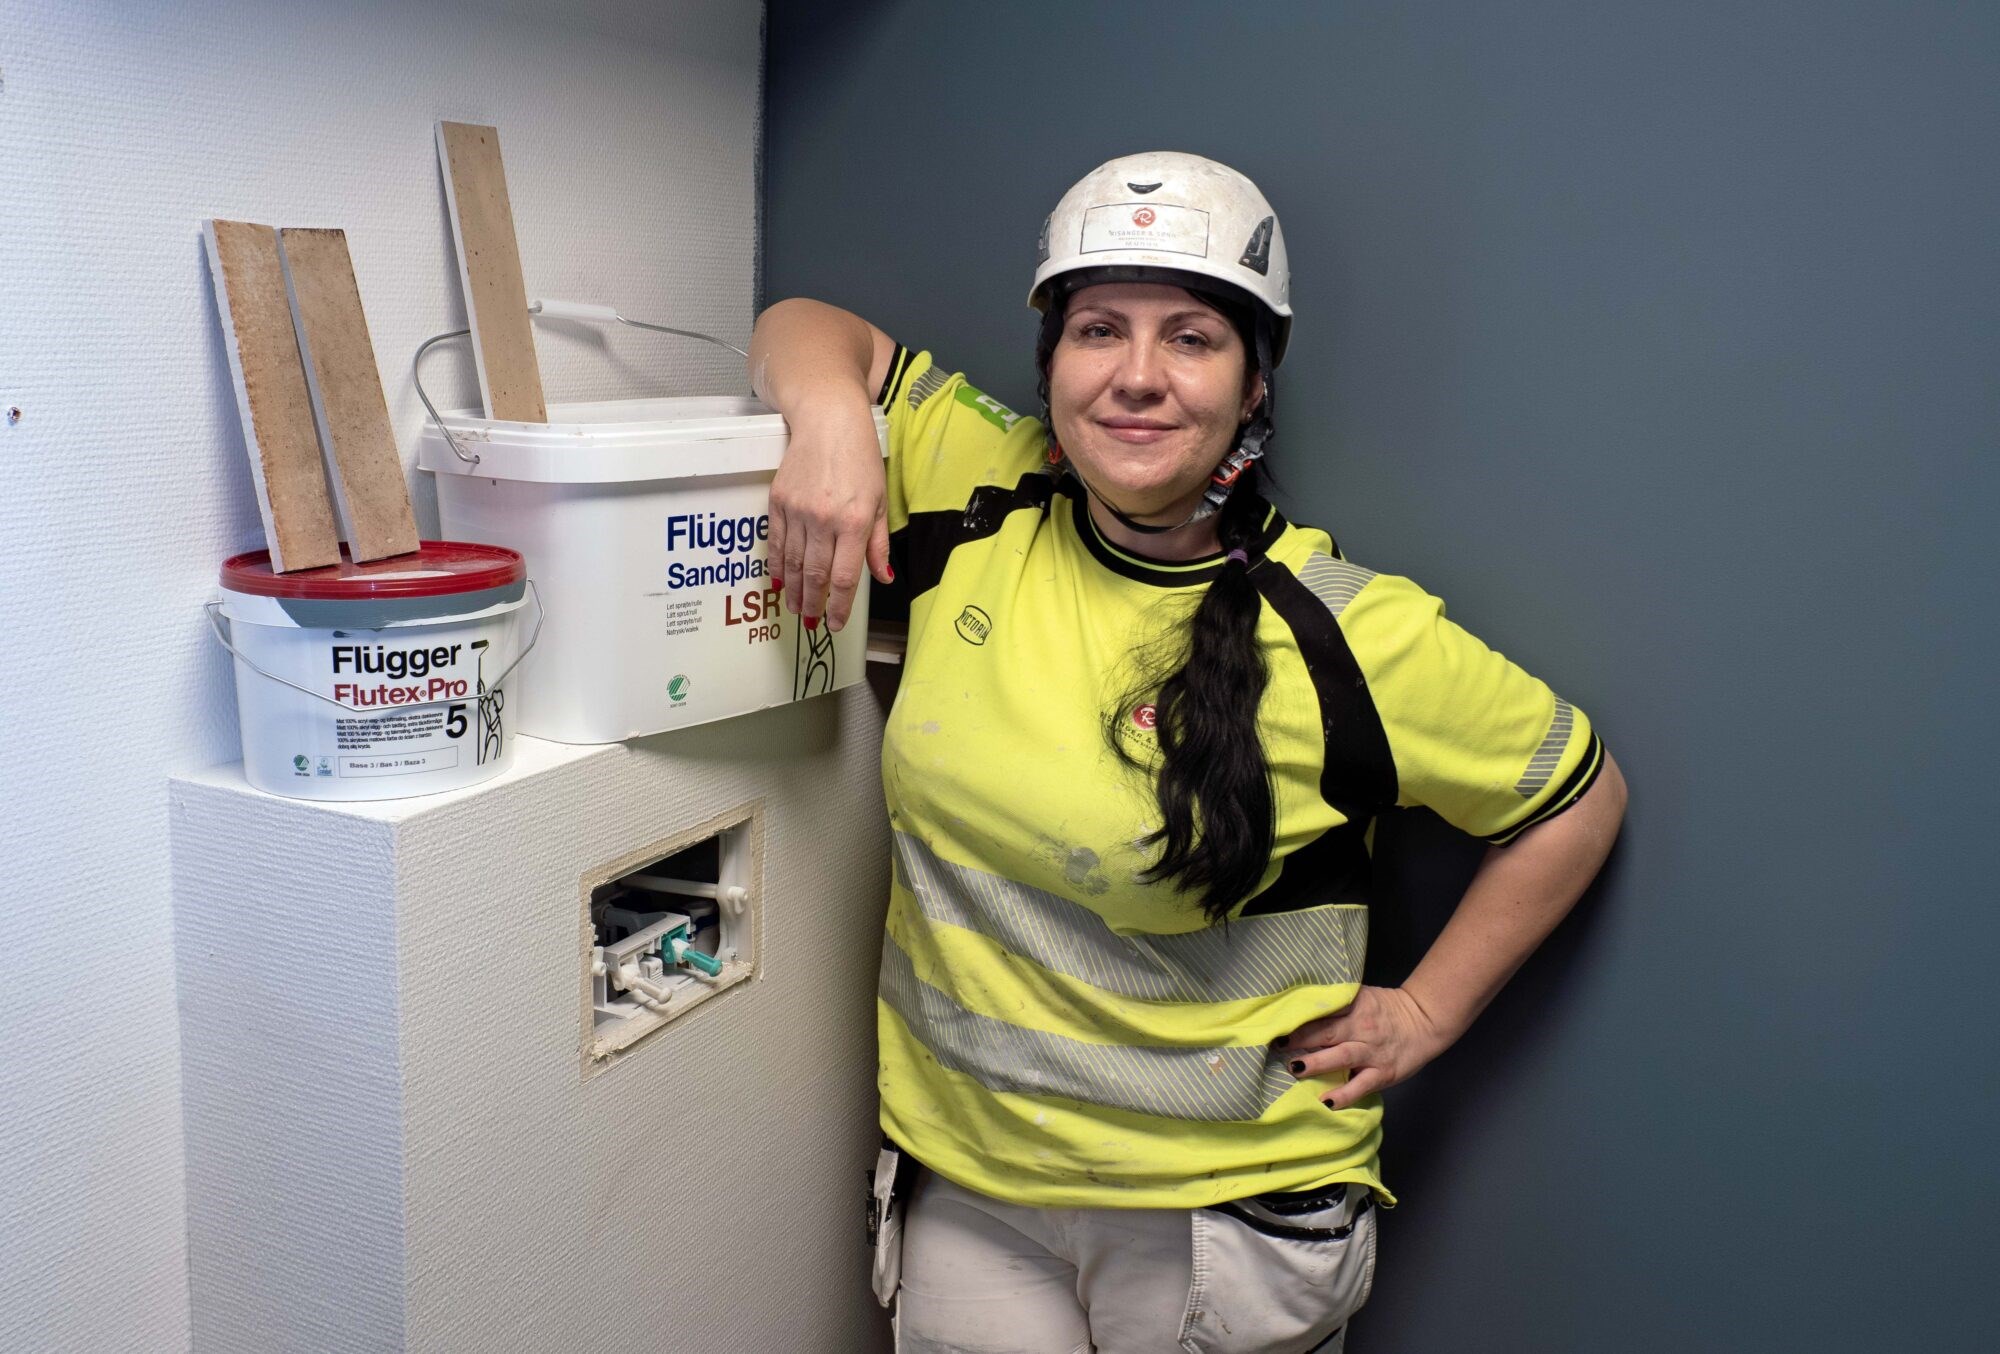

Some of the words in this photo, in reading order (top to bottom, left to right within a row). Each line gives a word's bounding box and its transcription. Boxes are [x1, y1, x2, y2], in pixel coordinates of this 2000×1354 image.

[667, 512, 769, 555] Flügge
[667, 554, 769, 590] Sandpla
[725, 588, 781, 626] LSR
[749, 623, 781, 644] PRO
[332, 644, 462, 680] Flügger
[445, 703, 468, 739] 5
